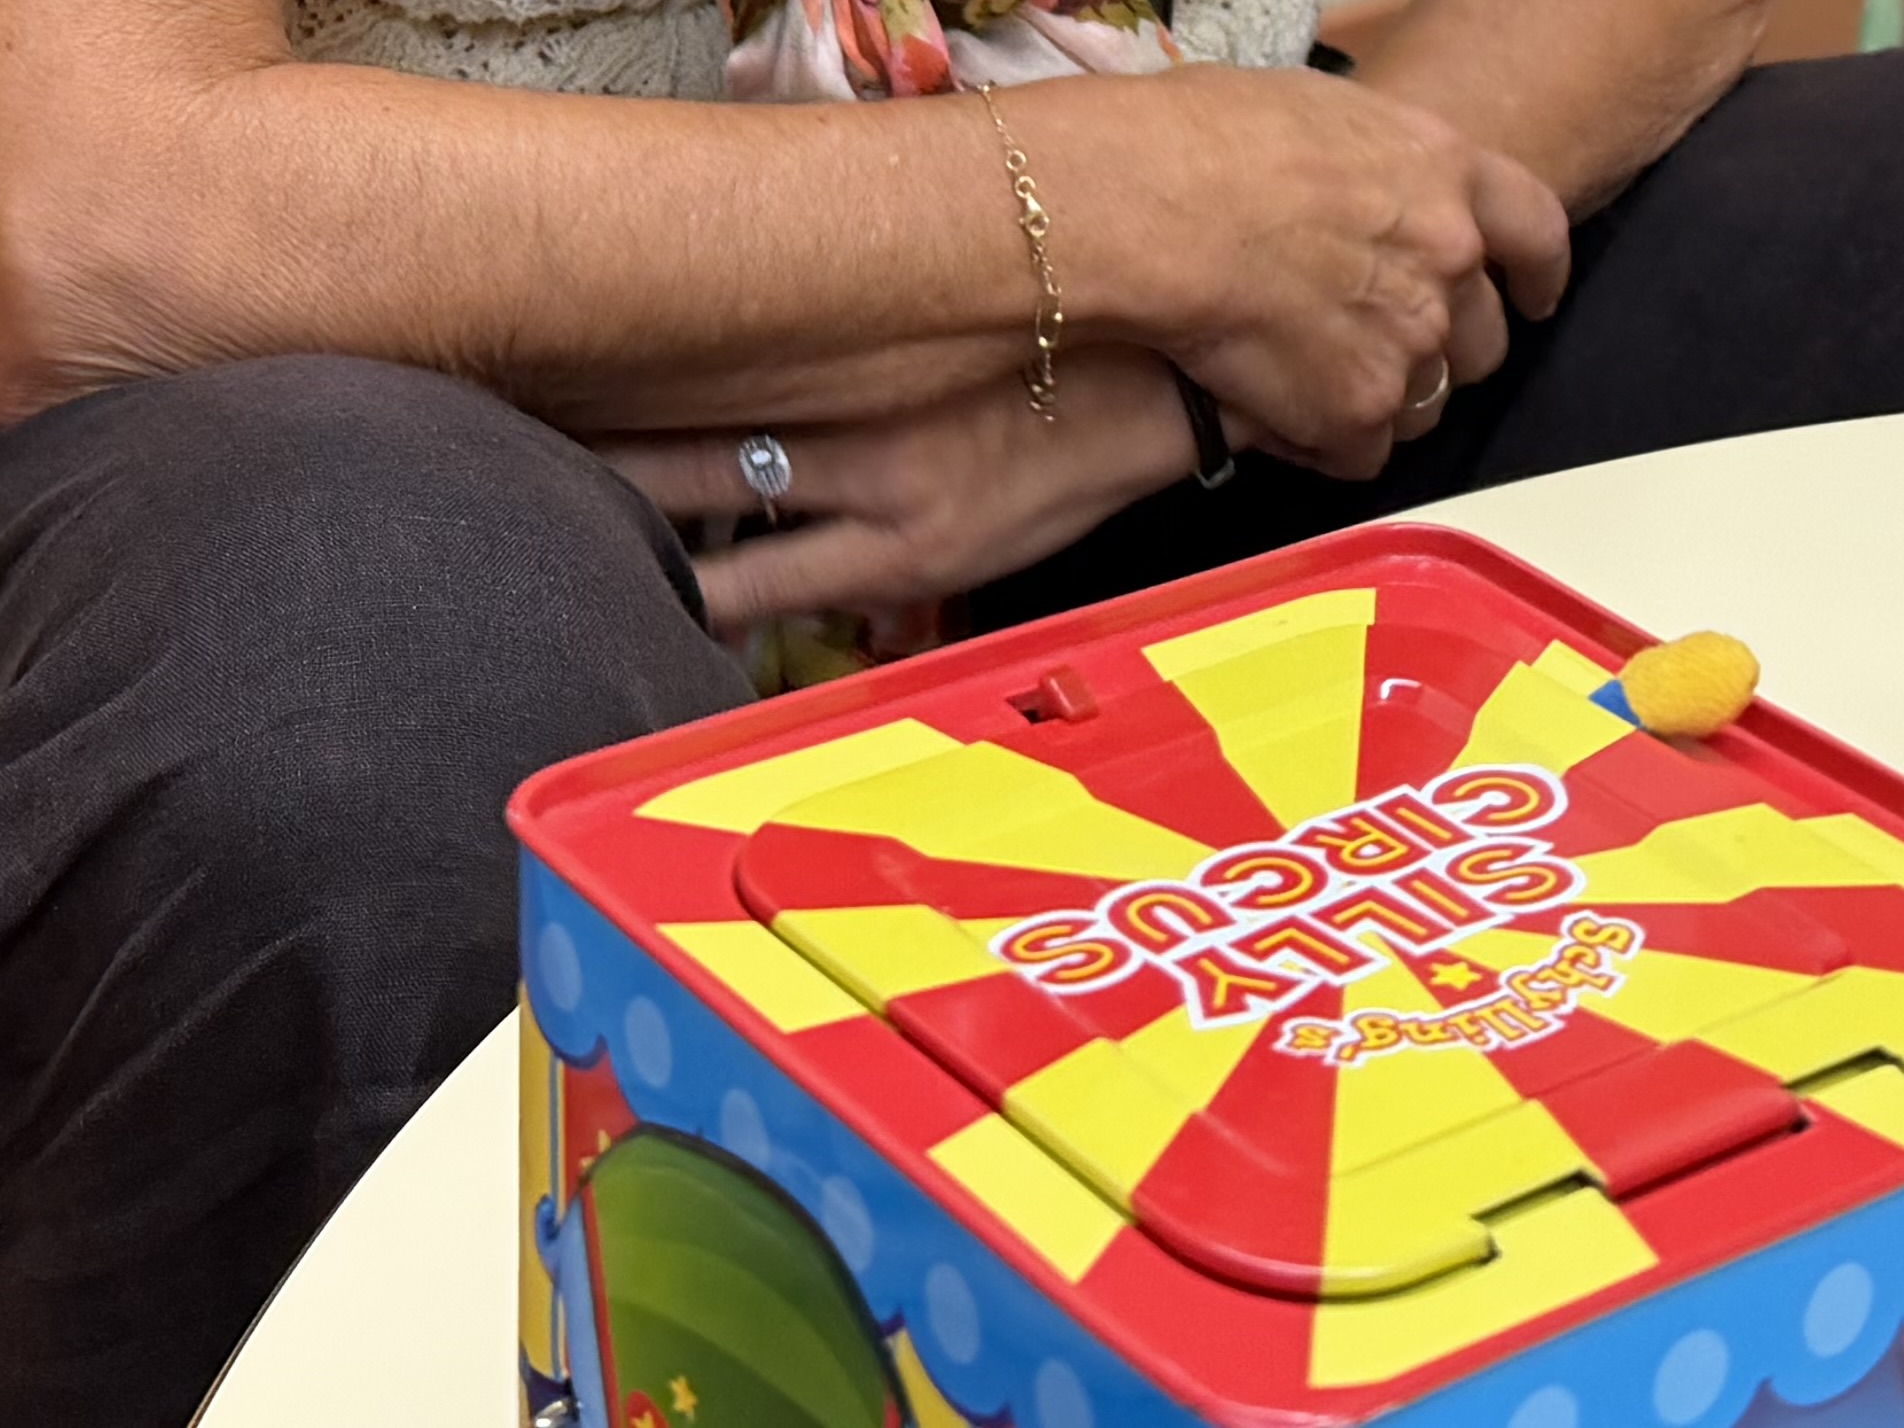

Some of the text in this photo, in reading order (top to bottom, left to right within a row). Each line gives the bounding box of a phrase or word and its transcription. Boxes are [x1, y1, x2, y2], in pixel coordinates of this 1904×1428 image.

[995, 767, 1563, 989] CIRCUS
[1166, 839, 1580, 1024] SILLY
[1281, 914, 1639, 1062] Schylling's
